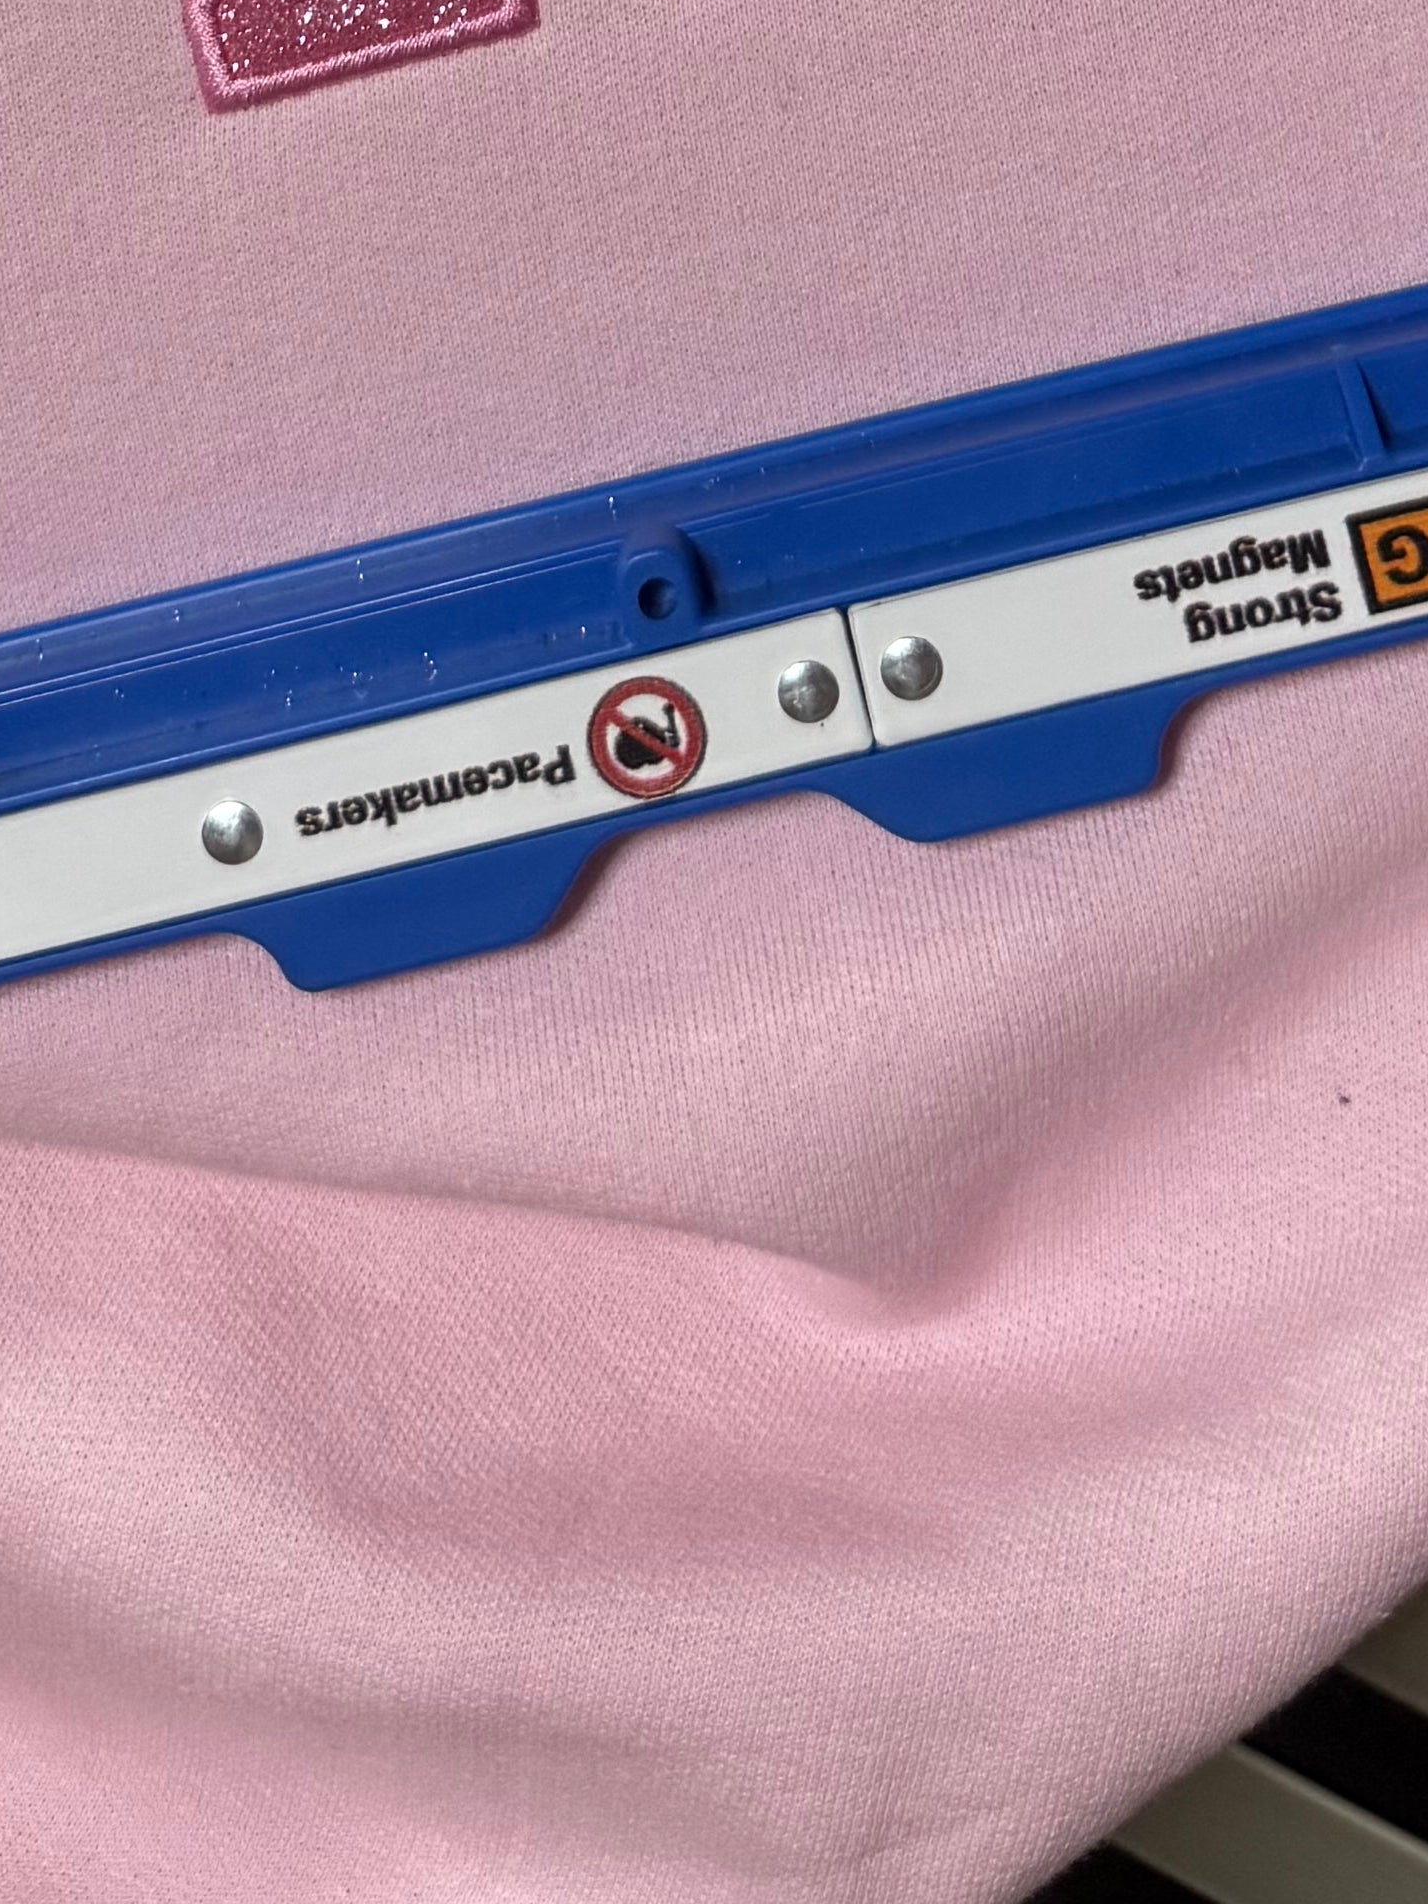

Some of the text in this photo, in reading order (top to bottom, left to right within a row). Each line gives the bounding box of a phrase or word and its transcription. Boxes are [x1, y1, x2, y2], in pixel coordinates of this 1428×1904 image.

[1133, 528, 1330, 602] Magnets
[1183, 580, 1342, 644] Strong
[295, 744, 576, 837] Pacemakers
